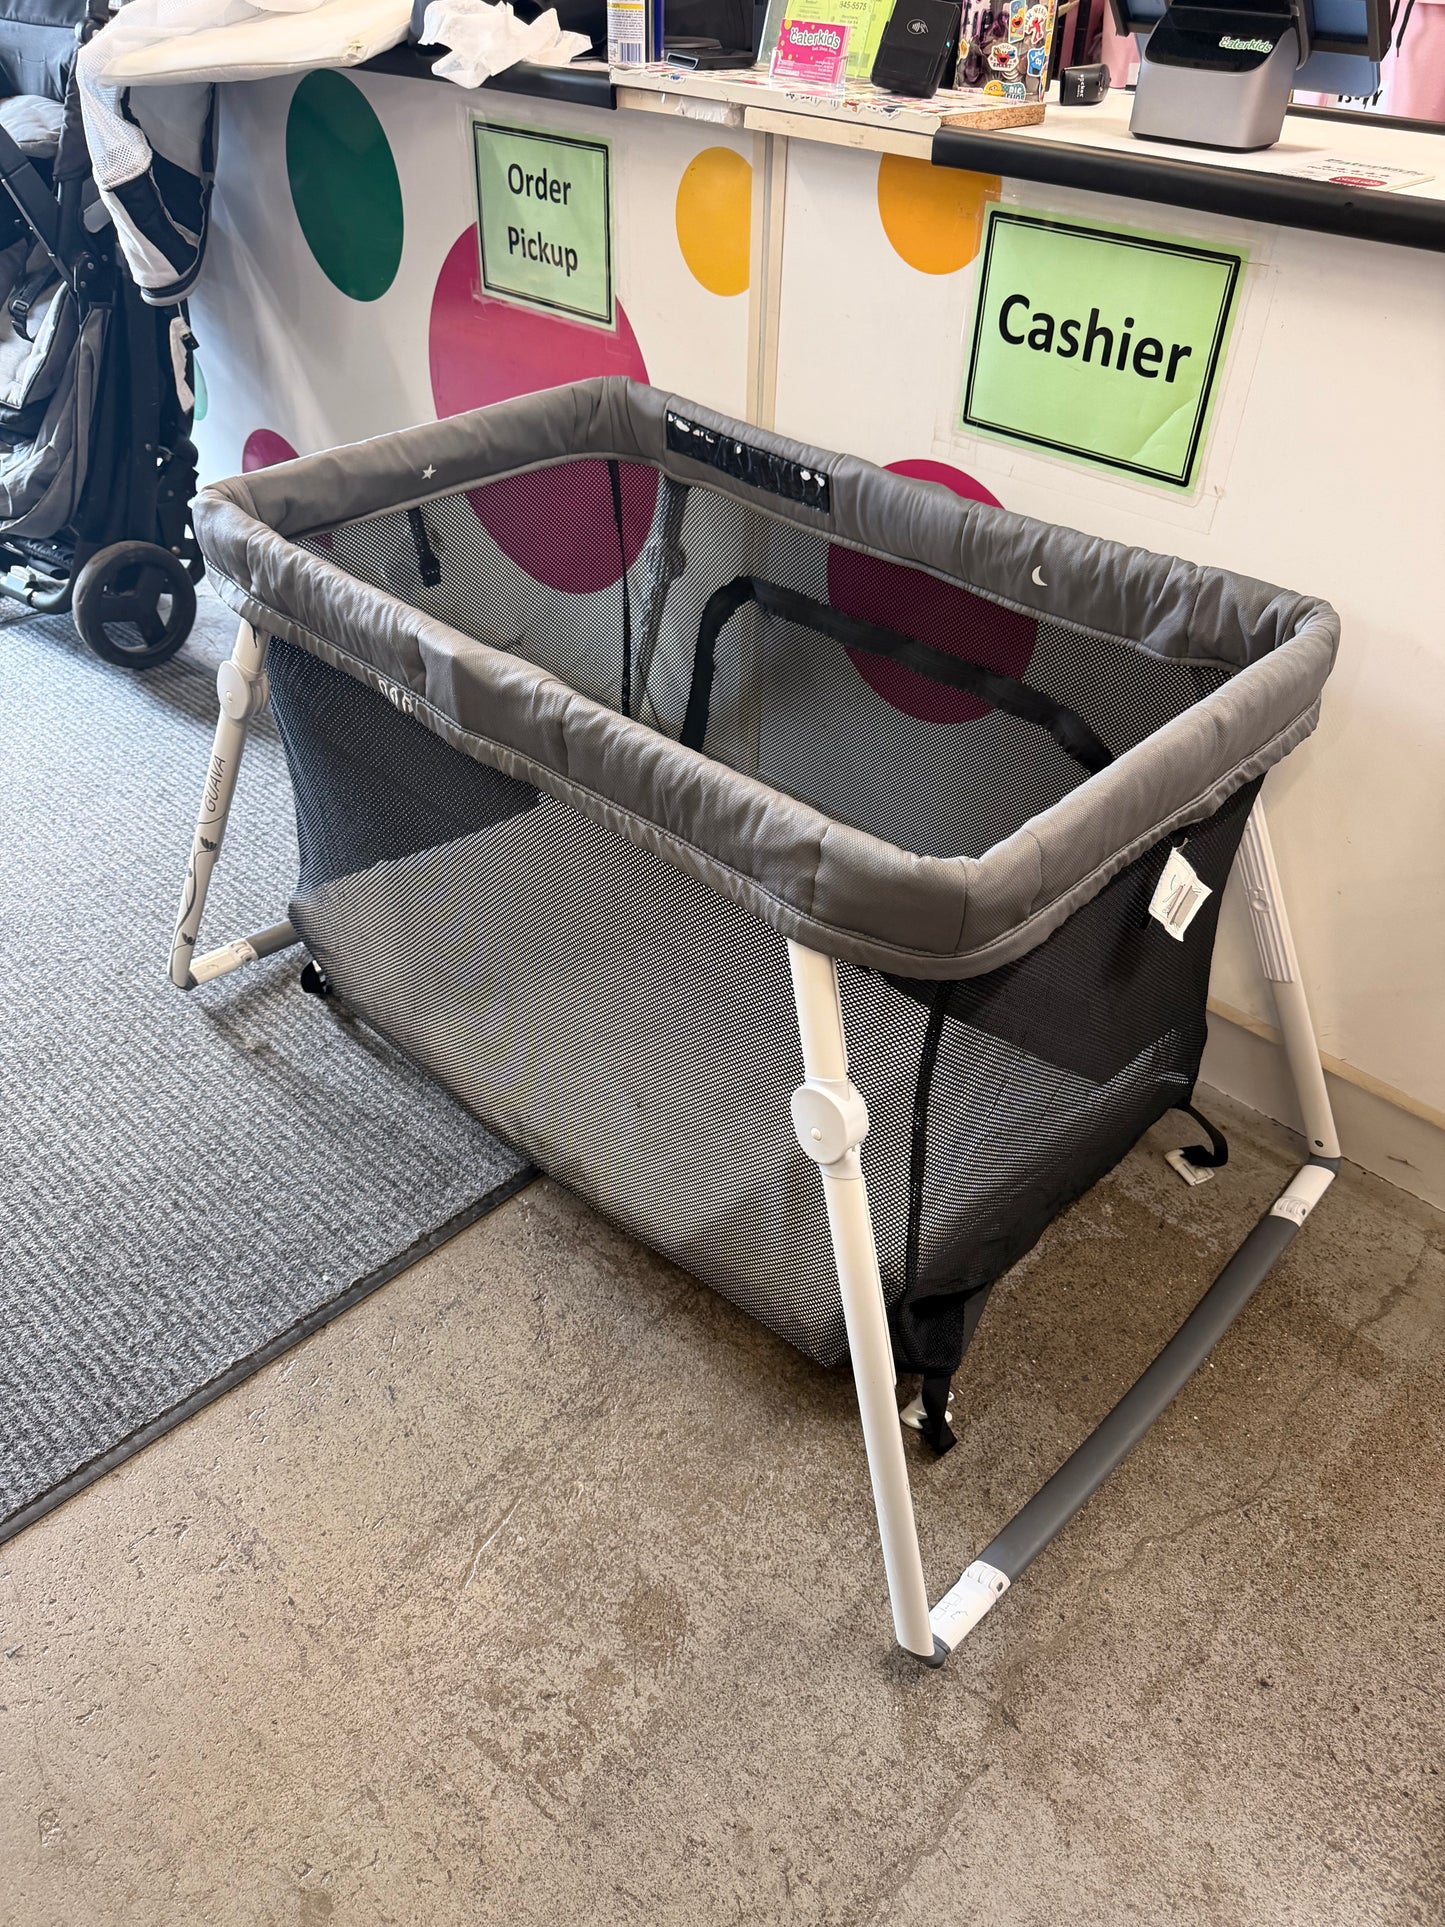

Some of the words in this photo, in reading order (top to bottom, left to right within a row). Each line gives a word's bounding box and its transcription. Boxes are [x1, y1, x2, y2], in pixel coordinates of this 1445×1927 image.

[790, 27, 840, 49] Caterkids
[1219, 36, 1273, 53] Caterkids
[508, 163, 571, 205] Order
[508, 226, 578, 277] Pickup
[999, 294, 1192, 383] Cashier
[205, 755, 226, 812] GUAVA
